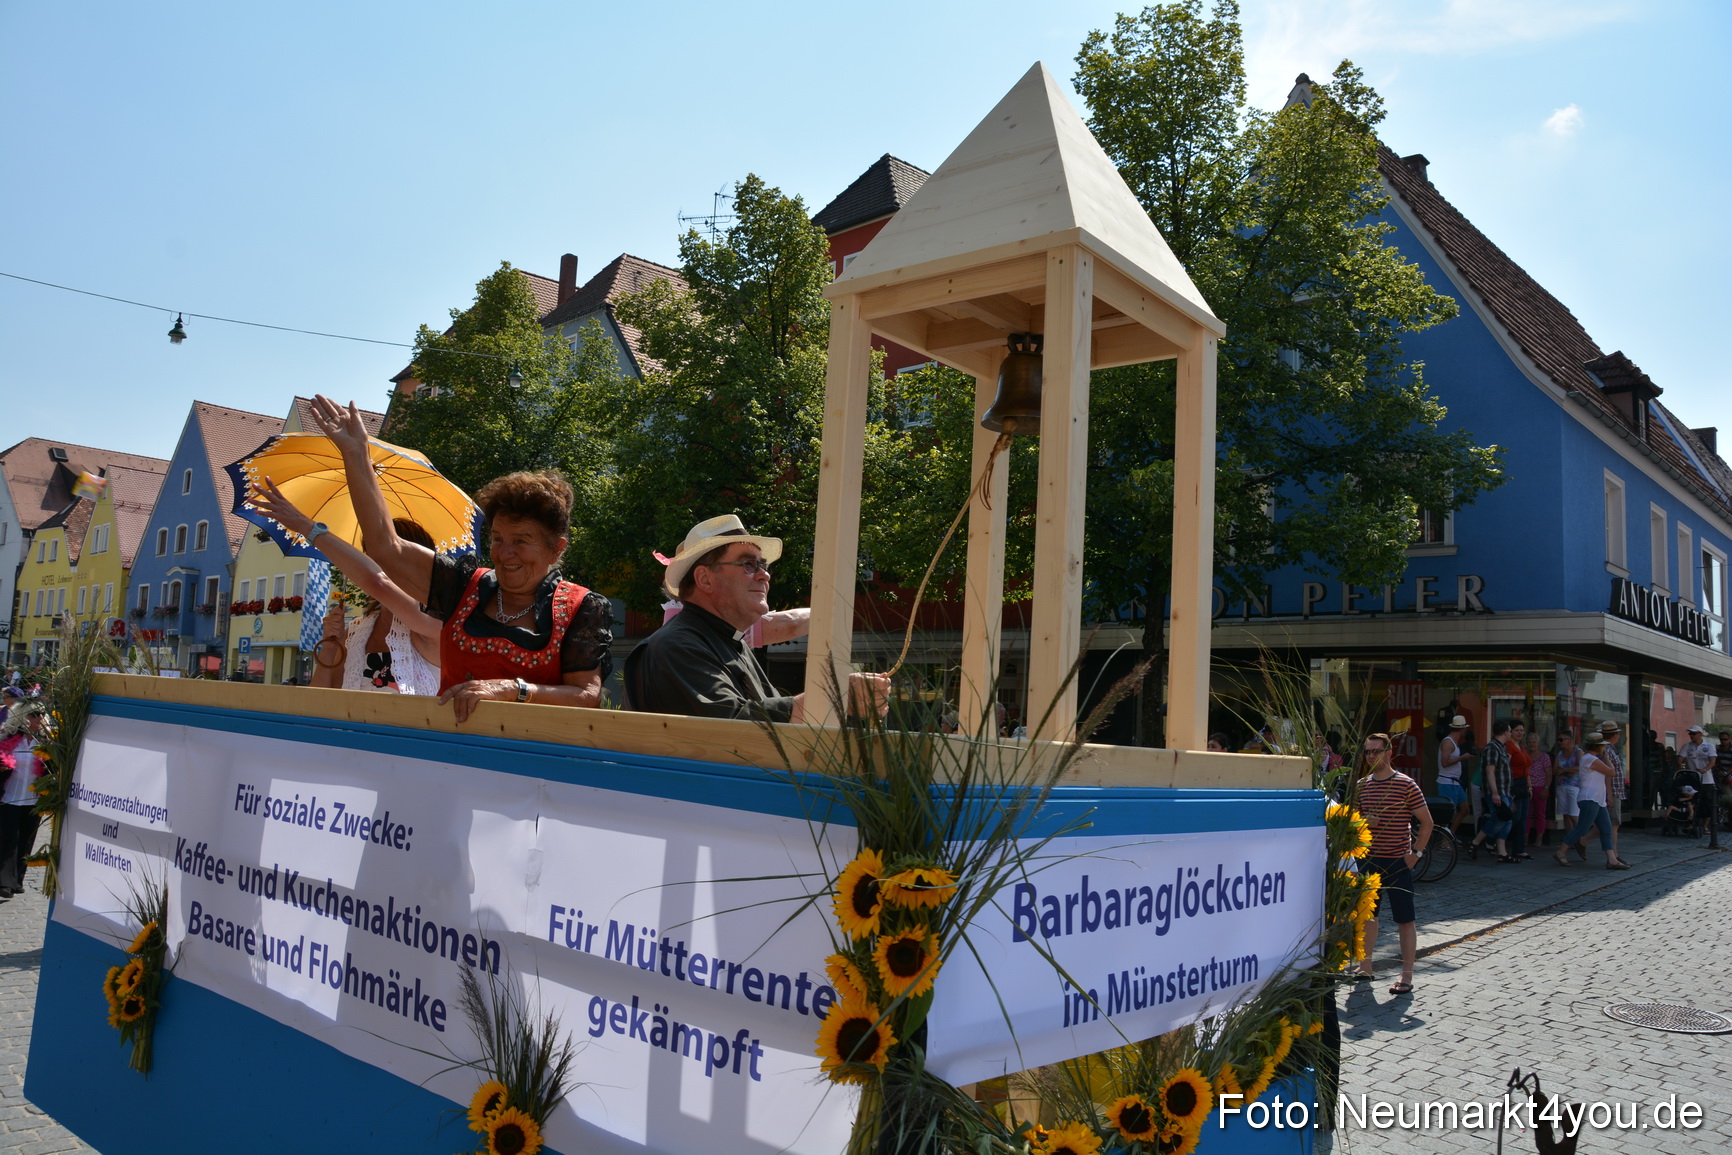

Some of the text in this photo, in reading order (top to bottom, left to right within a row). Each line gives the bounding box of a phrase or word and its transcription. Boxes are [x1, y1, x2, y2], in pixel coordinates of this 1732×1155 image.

[1302, 575, 1486, 617] PETER
[1619, 579, 1713, 646] ANTON PETER
[240, 639, 248, 653] P
[1387, 684, 1422, 710] SALE!
[70, 782, 168, 823] Bildungsveranstaltungen
[102, 822, 119, 839] und
[234, 782, 413, 852] Für soziale Zwecke:
[85, 842, 132, 873] Wallfahrten
[174, 836, 500, 976] Kaffee- und Kuchenaktionen
[1012, 861, 1286, 942] Barbaraglöckchen
[188, 900, 447, 1033] Basare und Flohmärke
[548, 904, 836, 1021] Für Mütterrente
[1063, 954, 1258, 1028] im Münsterturm
[587, 995, 764, 1082] gekämpft
